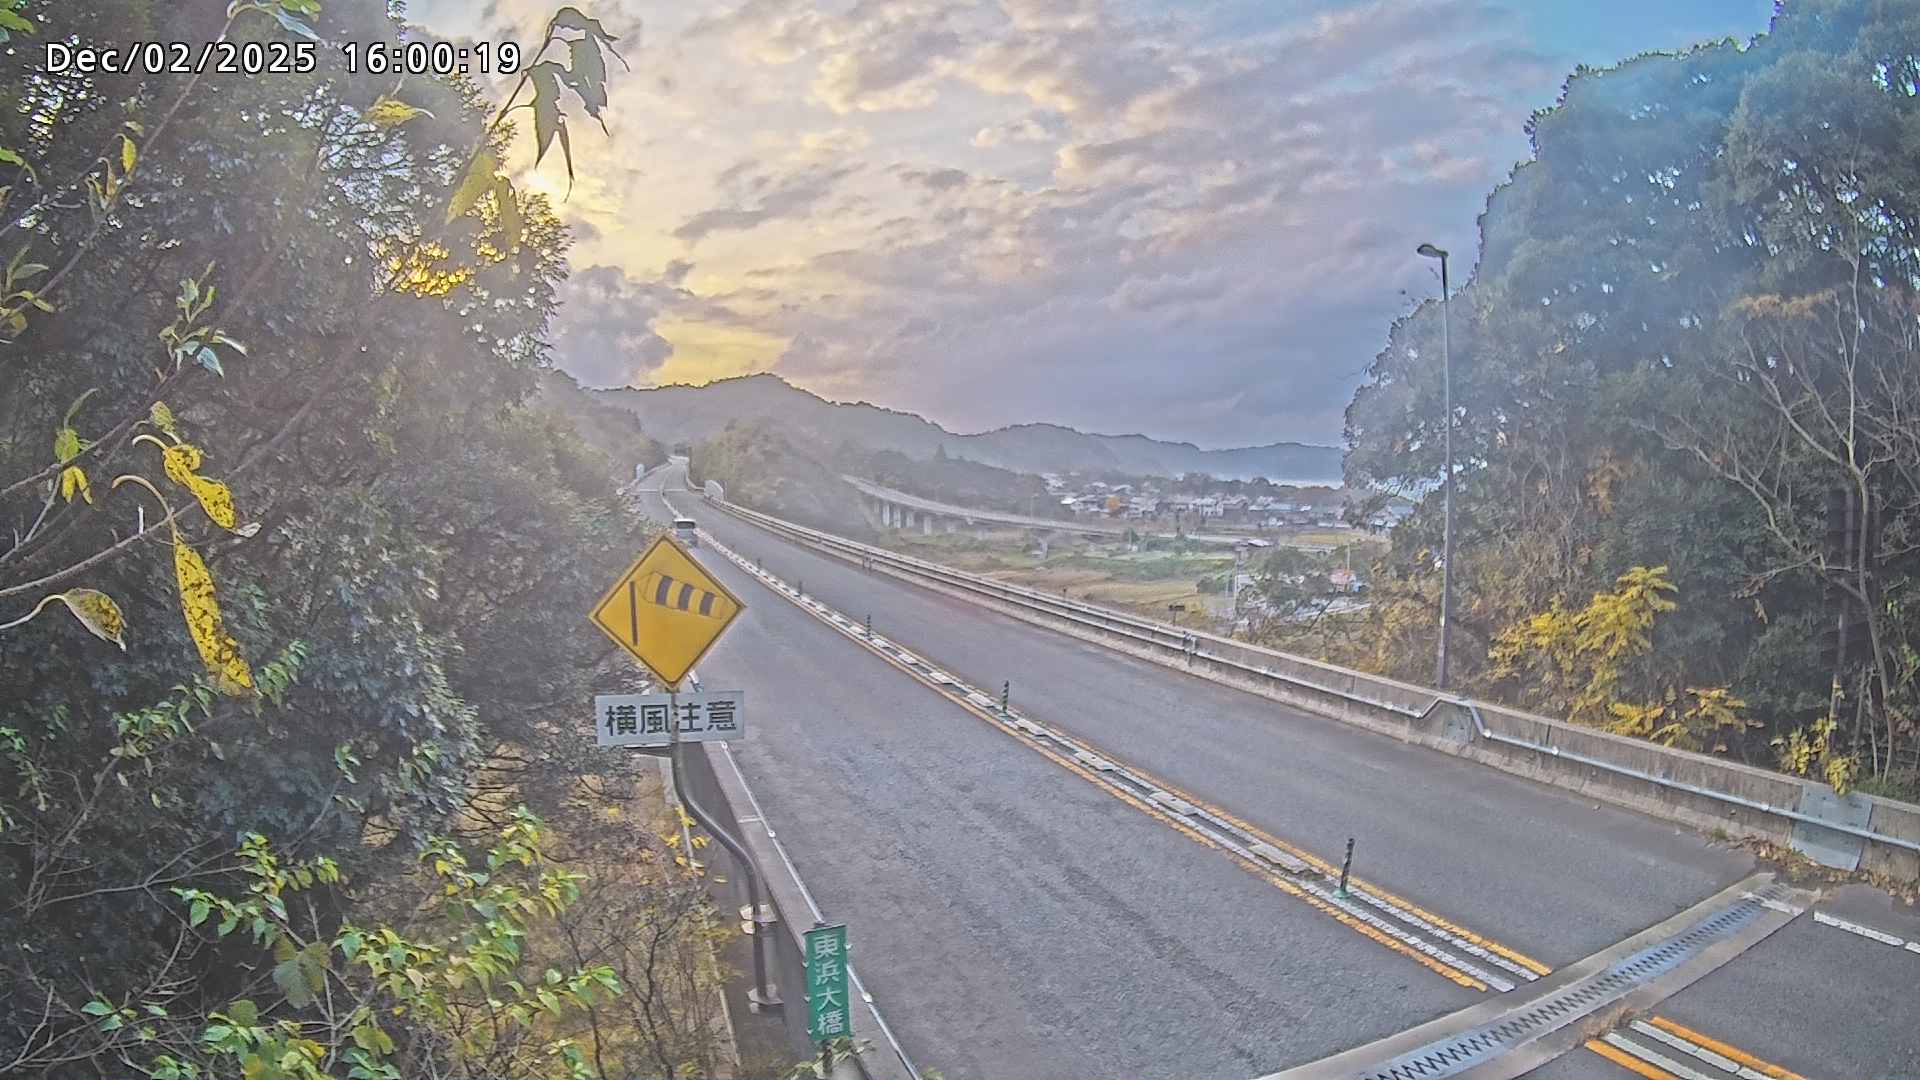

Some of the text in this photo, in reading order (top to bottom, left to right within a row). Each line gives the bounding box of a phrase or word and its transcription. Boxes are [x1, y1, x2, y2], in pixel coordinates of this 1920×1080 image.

[605, 700, 737, 737] 横風注意
[814, 934, 844, 1035] 東浜大橋
